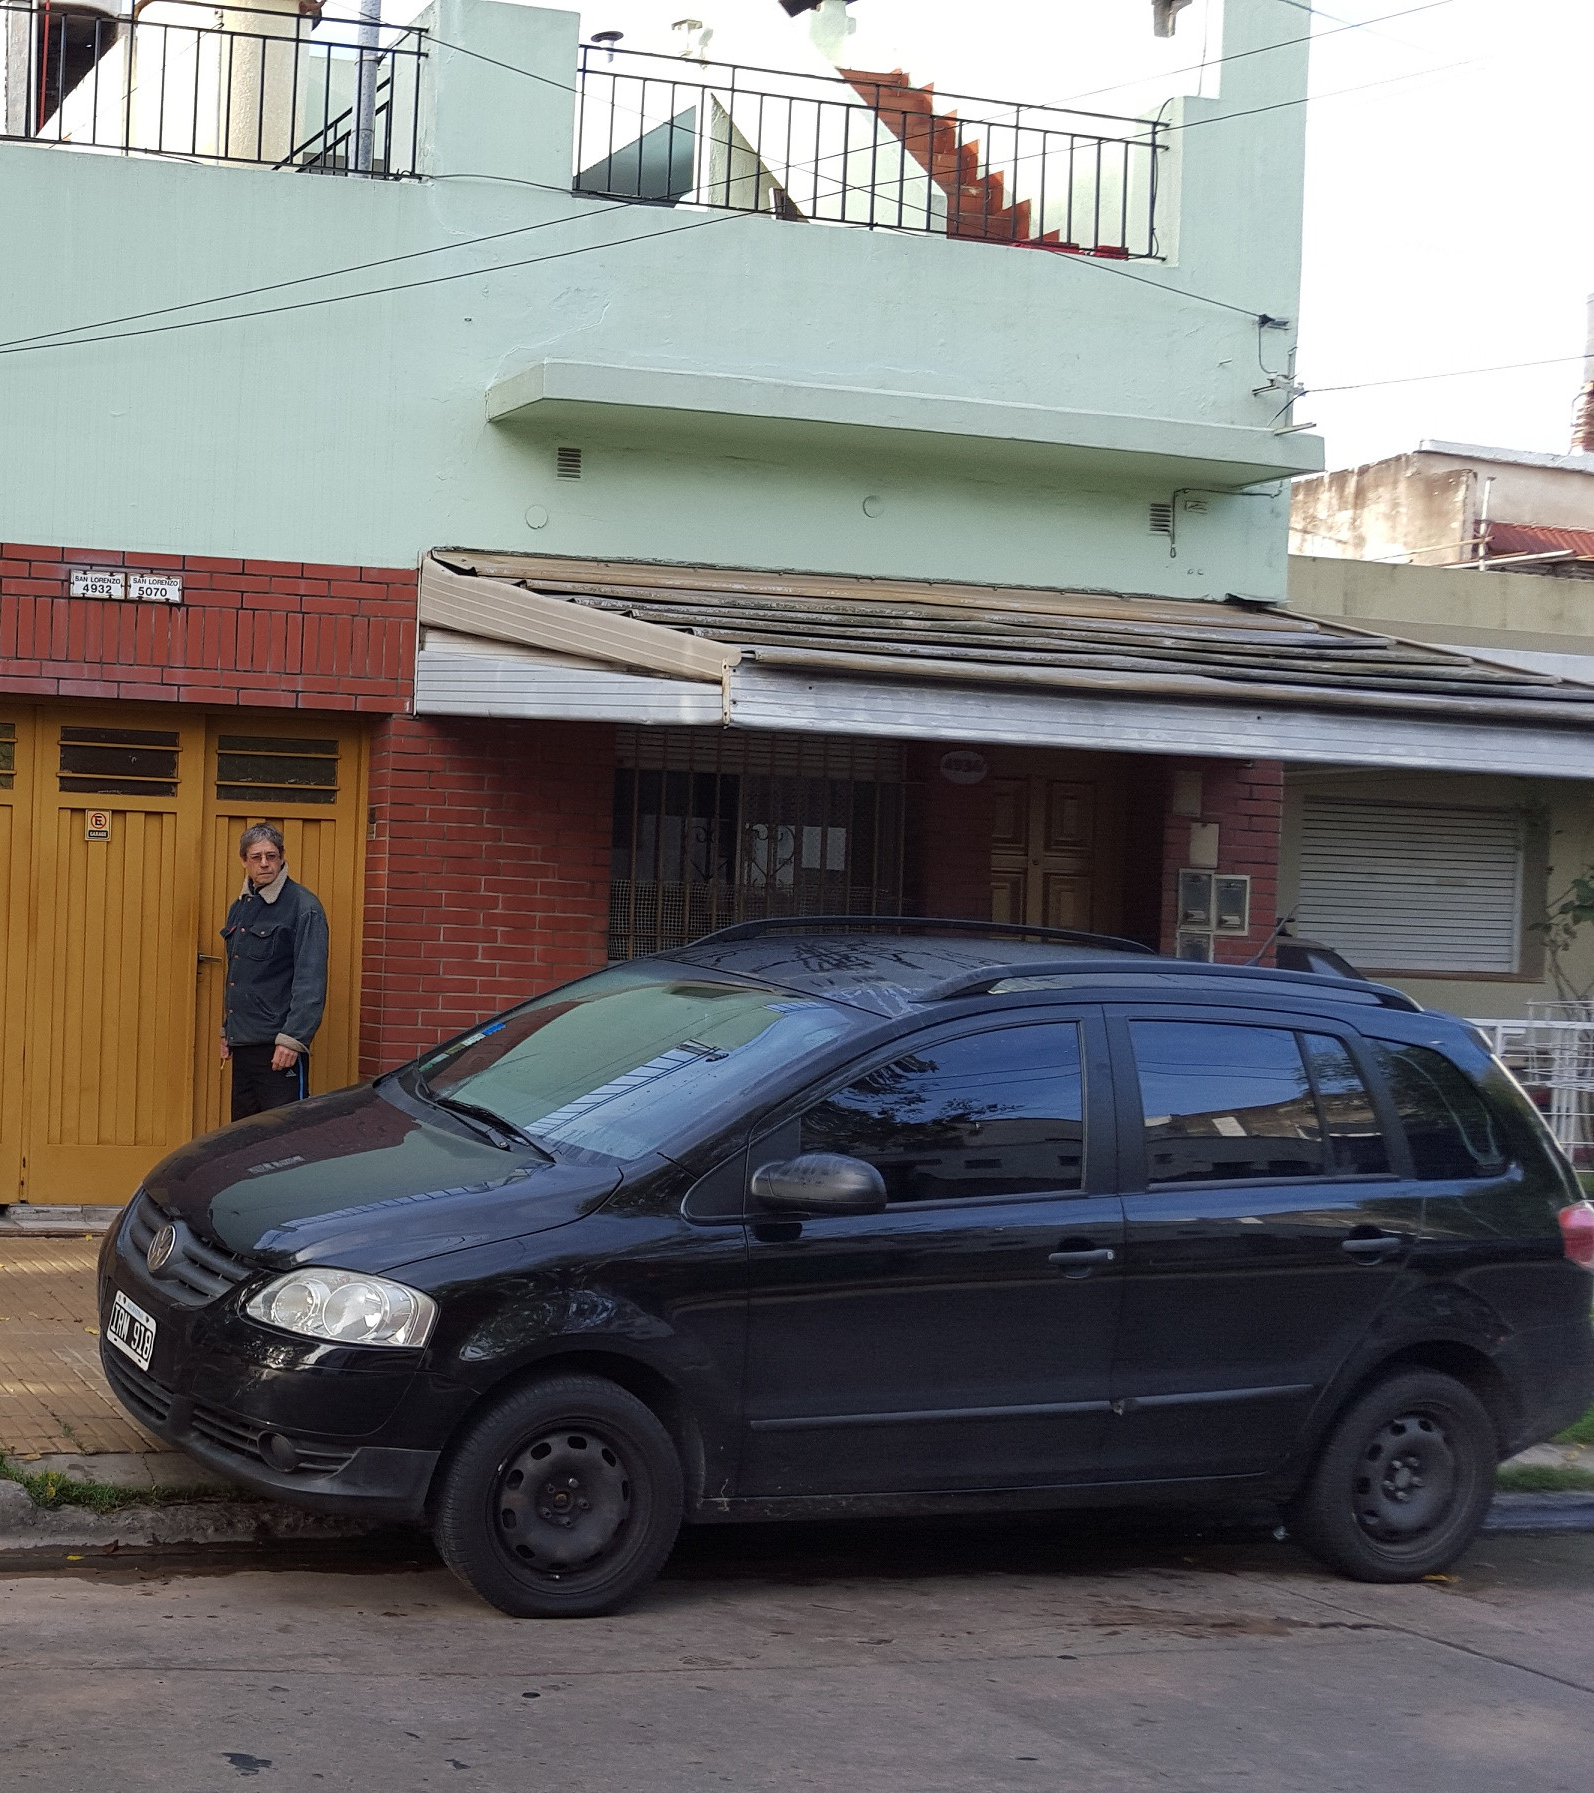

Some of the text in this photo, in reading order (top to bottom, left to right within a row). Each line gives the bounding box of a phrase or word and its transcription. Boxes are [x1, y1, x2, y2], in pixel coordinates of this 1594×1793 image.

[74, 575, 121, 585] SAN LORENZO
[148, 578, 179, 587] LORENZO
[82, 583, 112, 594] 4932
[137, 586, 168, 598] 5070
[131, 1322, 152, 1360] 918
